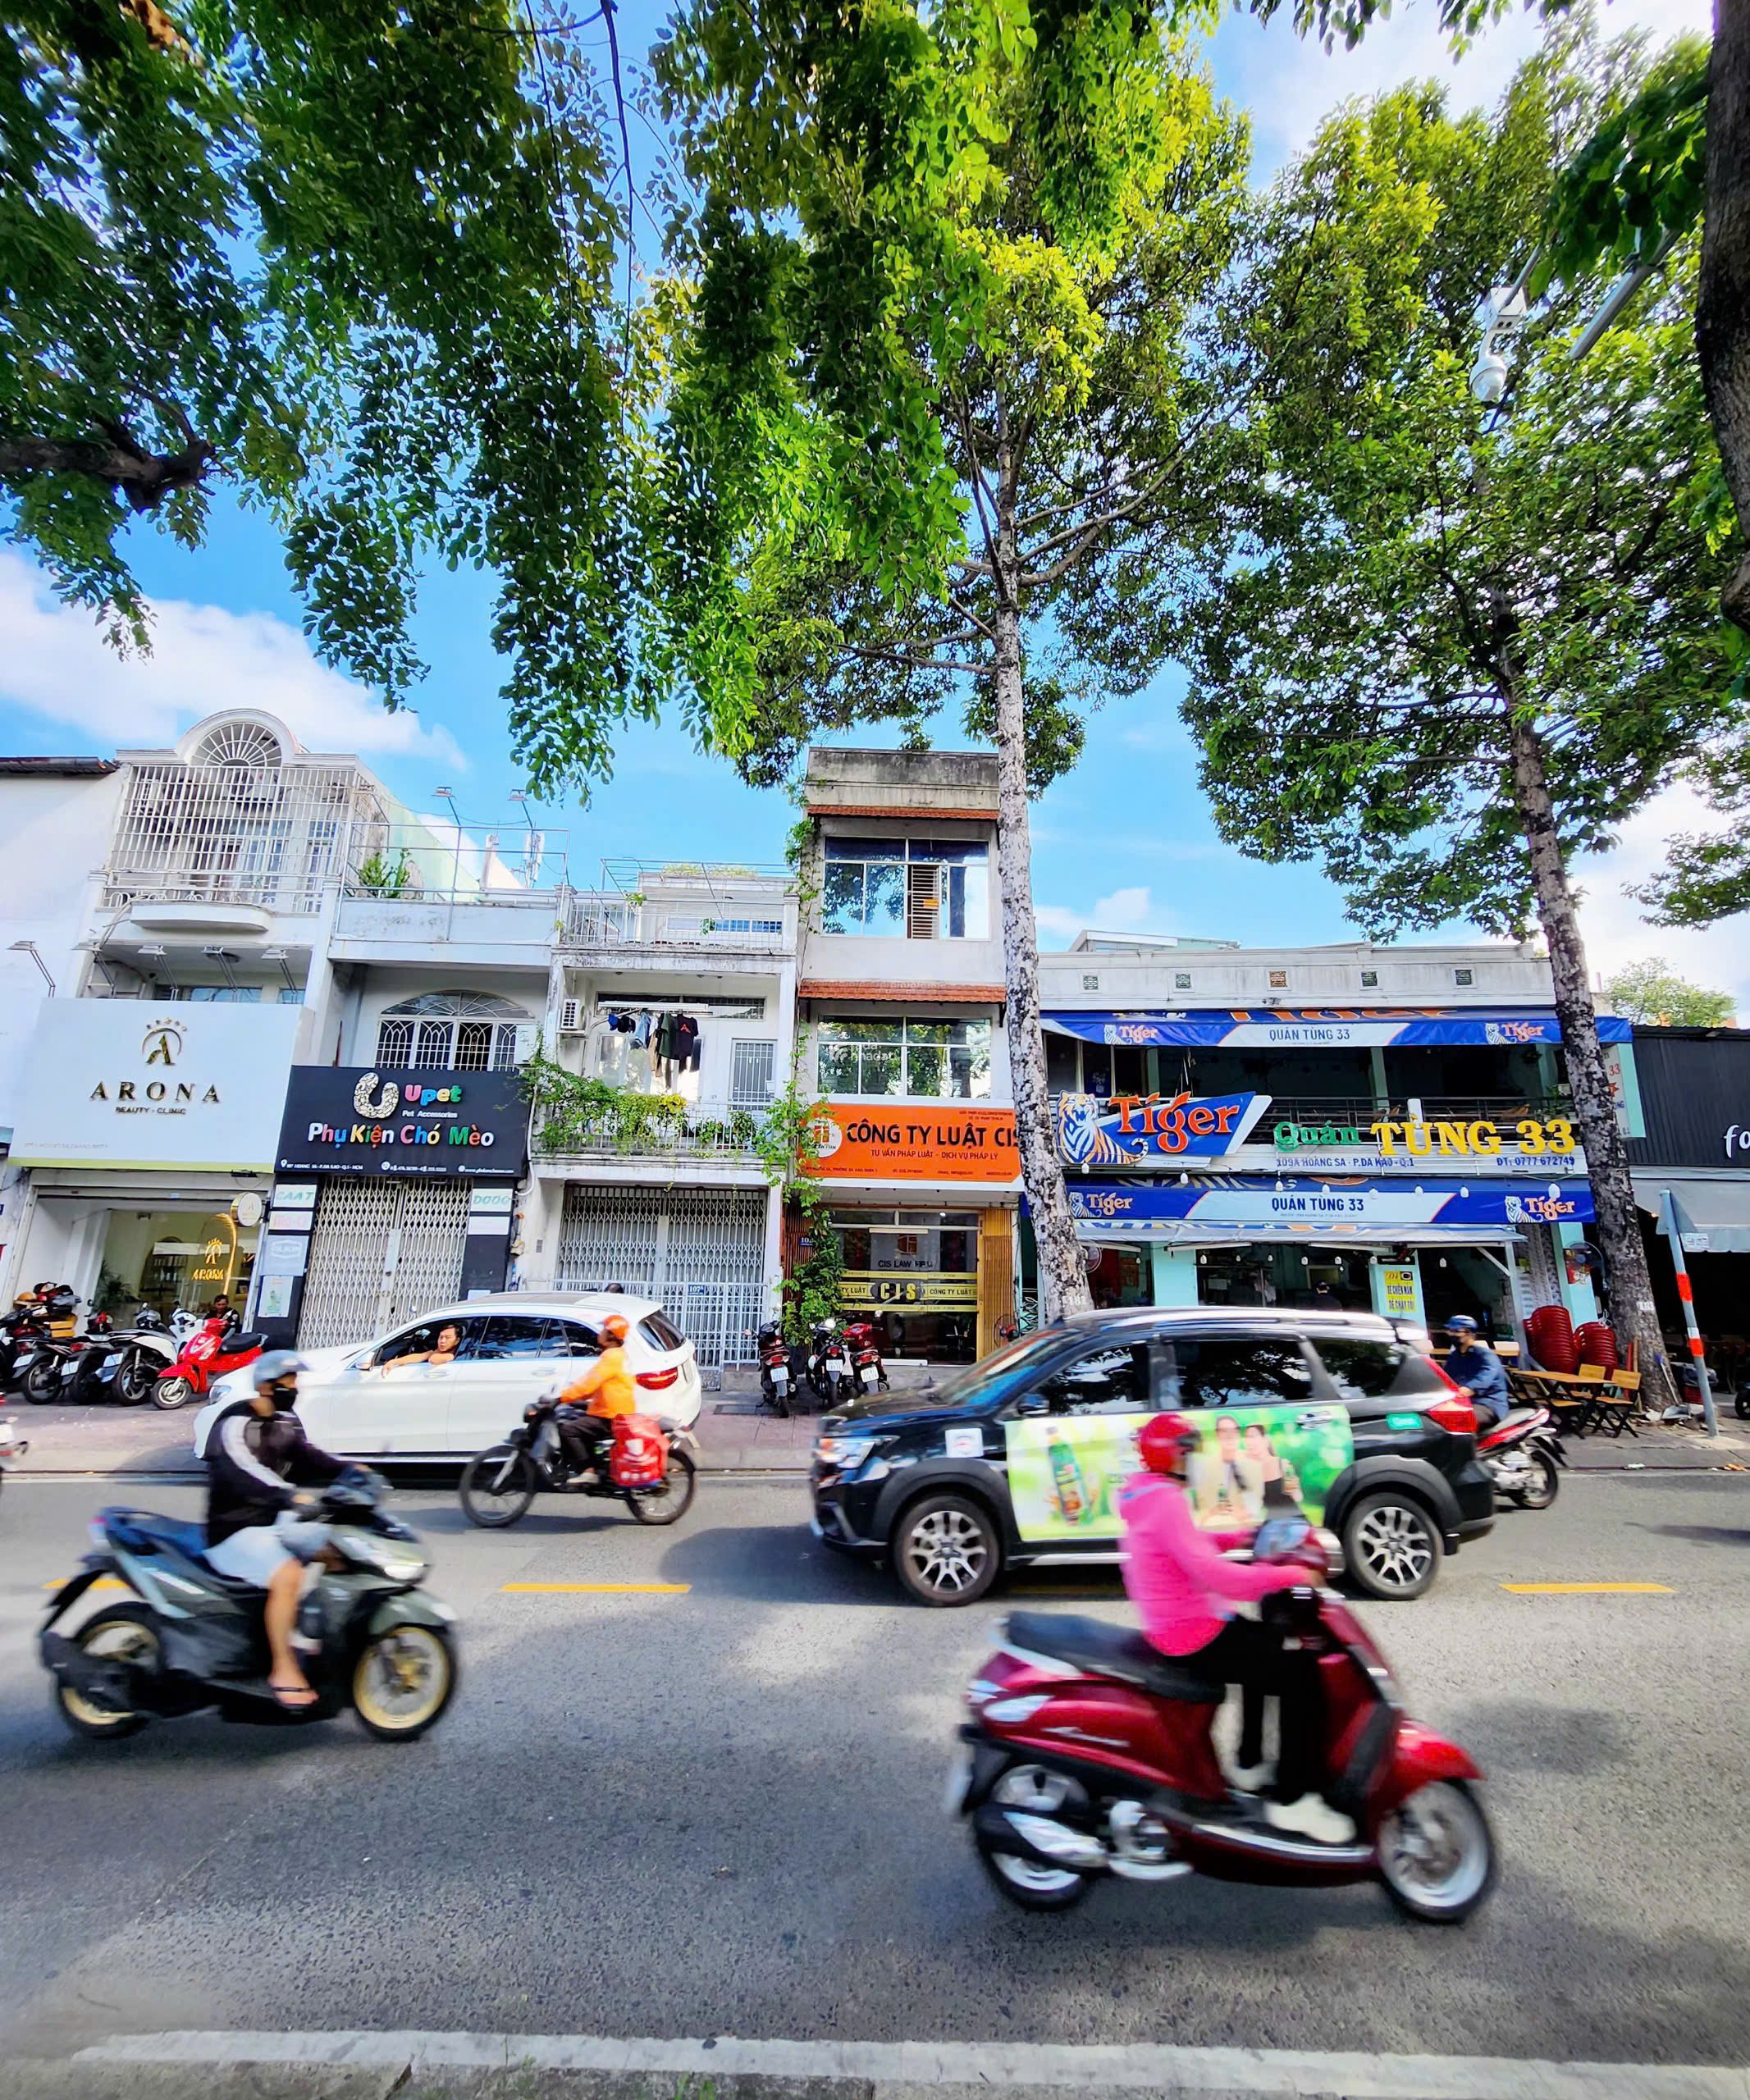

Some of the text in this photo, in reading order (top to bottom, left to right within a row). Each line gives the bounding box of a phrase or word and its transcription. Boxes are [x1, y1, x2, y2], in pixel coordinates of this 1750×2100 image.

[1119, 1025, 1158, 1043] Tiger
[1269, 1026, 1350, 1041] QUÁN TÙNG 33
[1502, 1022, 1544, 1042] Tiger
[1609, 1063, 1621, 1076] 33
[89, 1080, 220, 1102] ARONA
[404, 1084, 463, 1106] Upet
[1108, 1091, 1241, 1153] Tiger
[308, 1122, 494, 1148] Phụ Kiện Chó Mèo
[847, 1117, 900, 1144] CÔNG
[907, 1125, 932, 1144] TY
[937, 1122, 988, 1150] LUẬT
[1273, 1119, 1361, 1152] Quán
[1516, 1119, 1575, 1154] 33
[1336, 1157, 1346, 1166] SA
[1399, 1157, 1414, 1167] Q.1
[1515, 1157, 1537, 1166] 0777
[1540, 1156, 1575, 1166] 672749
[1086, 1192, 1133, 1215] Tiger
[1272, 1194, 1364, 1211] QUÁN TÙNG 33
[1524, 1197, 1575, 1221] Tiger
[878, 1260, 892, 1268] CIS
[893, 1260, 912, 1268] LAW
[880, 1282, 916, 1300] CIS
